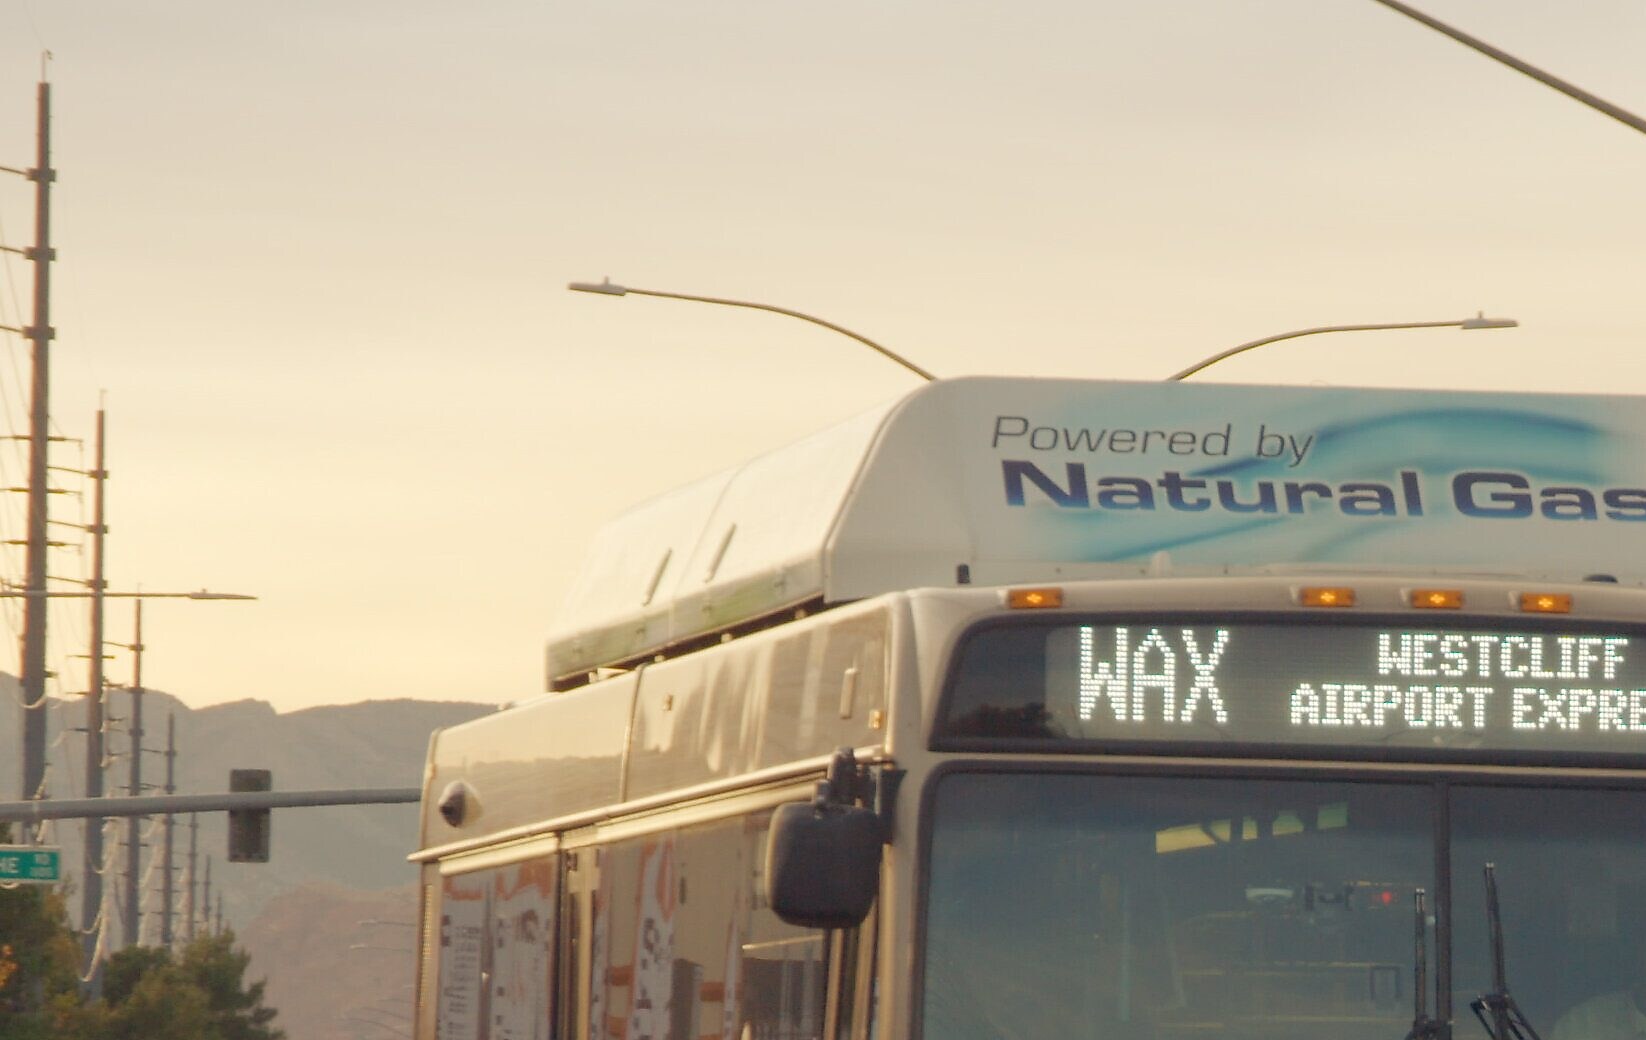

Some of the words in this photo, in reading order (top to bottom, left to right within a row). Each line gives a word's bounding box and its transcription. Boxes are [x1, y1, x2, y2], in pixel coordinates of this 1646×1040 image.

[991, 415, 1233, 458] Powered
[1255, 424, 1316, 468] by
[1000, 459, 1424, 517] Natural
[1079, 626, 1230, 724] WAX
[1377, 632, 1631, 680] WESTCLIFF
[1290, 682, 1495, 729] AIRPORT
